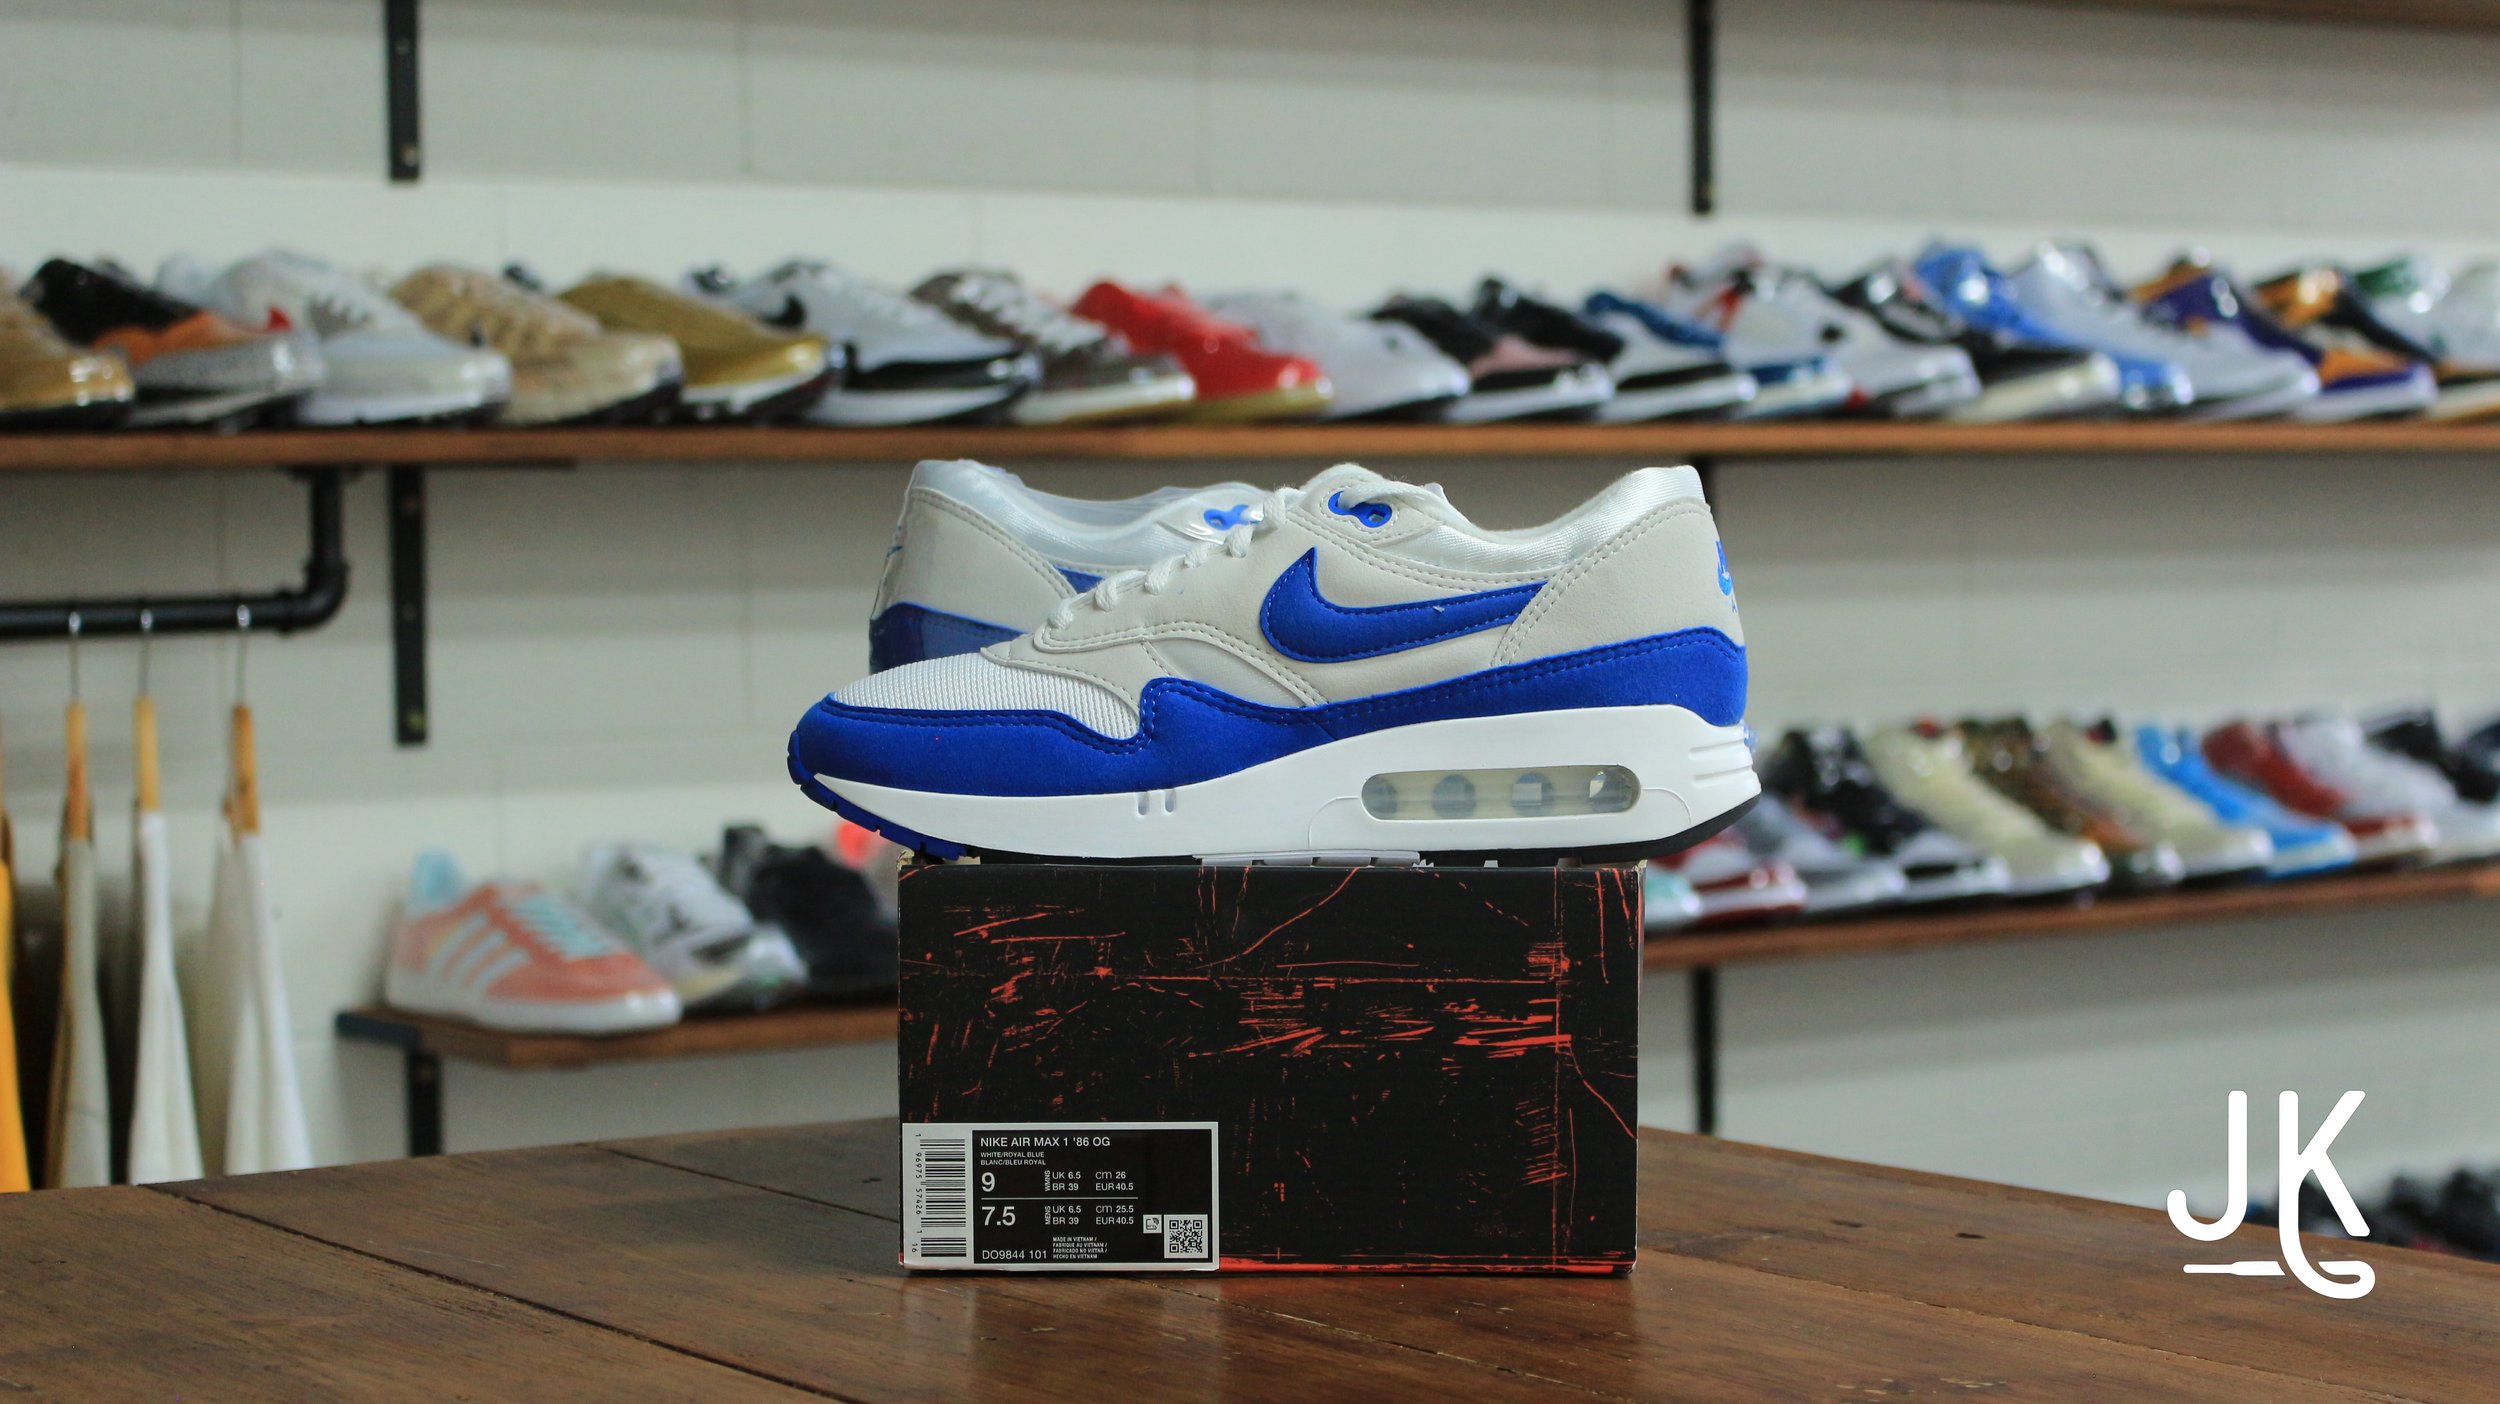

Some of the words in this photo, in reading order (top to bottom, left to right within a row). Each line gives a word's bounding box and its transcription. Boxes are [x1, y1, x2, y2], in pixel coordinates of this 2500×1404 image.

[980, 1137, 1008, 1147] NIKE
[1011, 1137, 1031, 1147] AIR
[1034, 1137, 1060, 1147] MAX
[1063, 1137, 1069, 1147] 1
[1073, 1136, 1089, 1147] '86
[1092, 1136, 1111, 1147] OG
[1052, 1171, 1065, 1180] UK
[1068, 1171, 1081, 1180] 6.5
[1115, 1171, 1127, 1179] 26
[981, 1172, 996, 1192] 9
[1052, 1182, 1066, 1191] BR
[1068, 1182, 1079, 1191] 39
[1095, 1182, 1115, 1191] EUR
[1115, 1182, 1134, 1191] 40.5
[915, 1188, 923, 1215] 57426
[1052, 1205, 1066, 1214] UK
[1068, 1205, 1082, 1214] 6.5
[1115, 1205, 1134, 1213] 25.5
[981, 1206, 1016, 1226] 7.5
[1052, 1216, 1066, 1225] BR
[1068, 1216, 1079, 1225] 39
[1095, 1216, 1115, 1225] EUR
[1115, 1216, 1134, 1225] 40.5
[1029, 1249, 1047, 1260] 101
